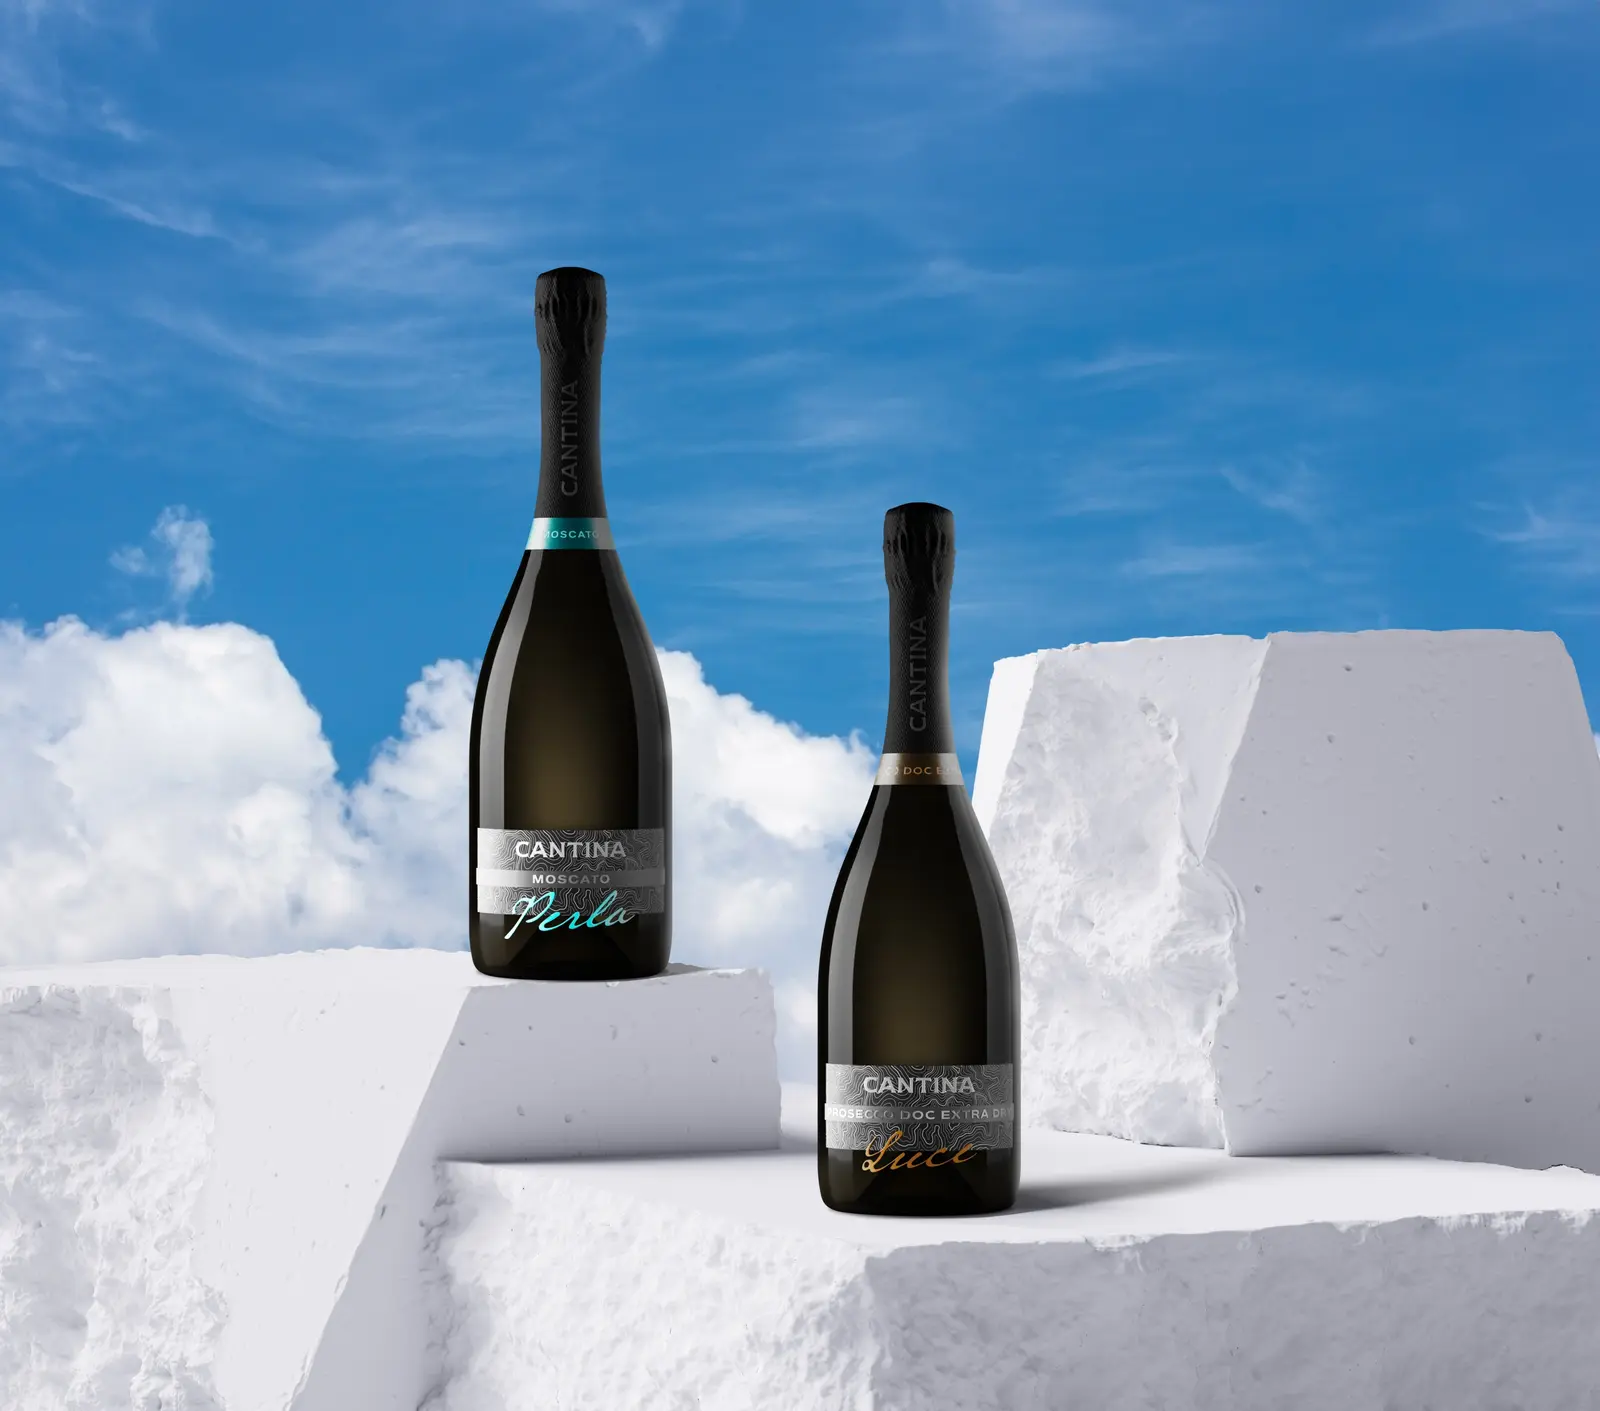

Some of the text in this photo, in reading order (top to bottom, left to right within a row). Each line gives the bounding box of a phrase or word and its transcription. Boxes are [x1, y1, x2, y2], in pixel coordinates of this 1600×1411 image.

[561, 380, 578, 497] CANTINA
[909, 615, 927, 732] CANTINA
[903, 766, 932, 775] DOC
[515, 841, 627, 858] CANTINA
[532, 874, 610, 884] MOSCATO
[504, 890, 637, 940] Perla
[863, 1076, 976, 1094] CANTINA
[900, 1110, 936, 1120] DOC
[941, 1108, 989, 1120] EXTRA
[862, 1130, 978, 1173] Luce
